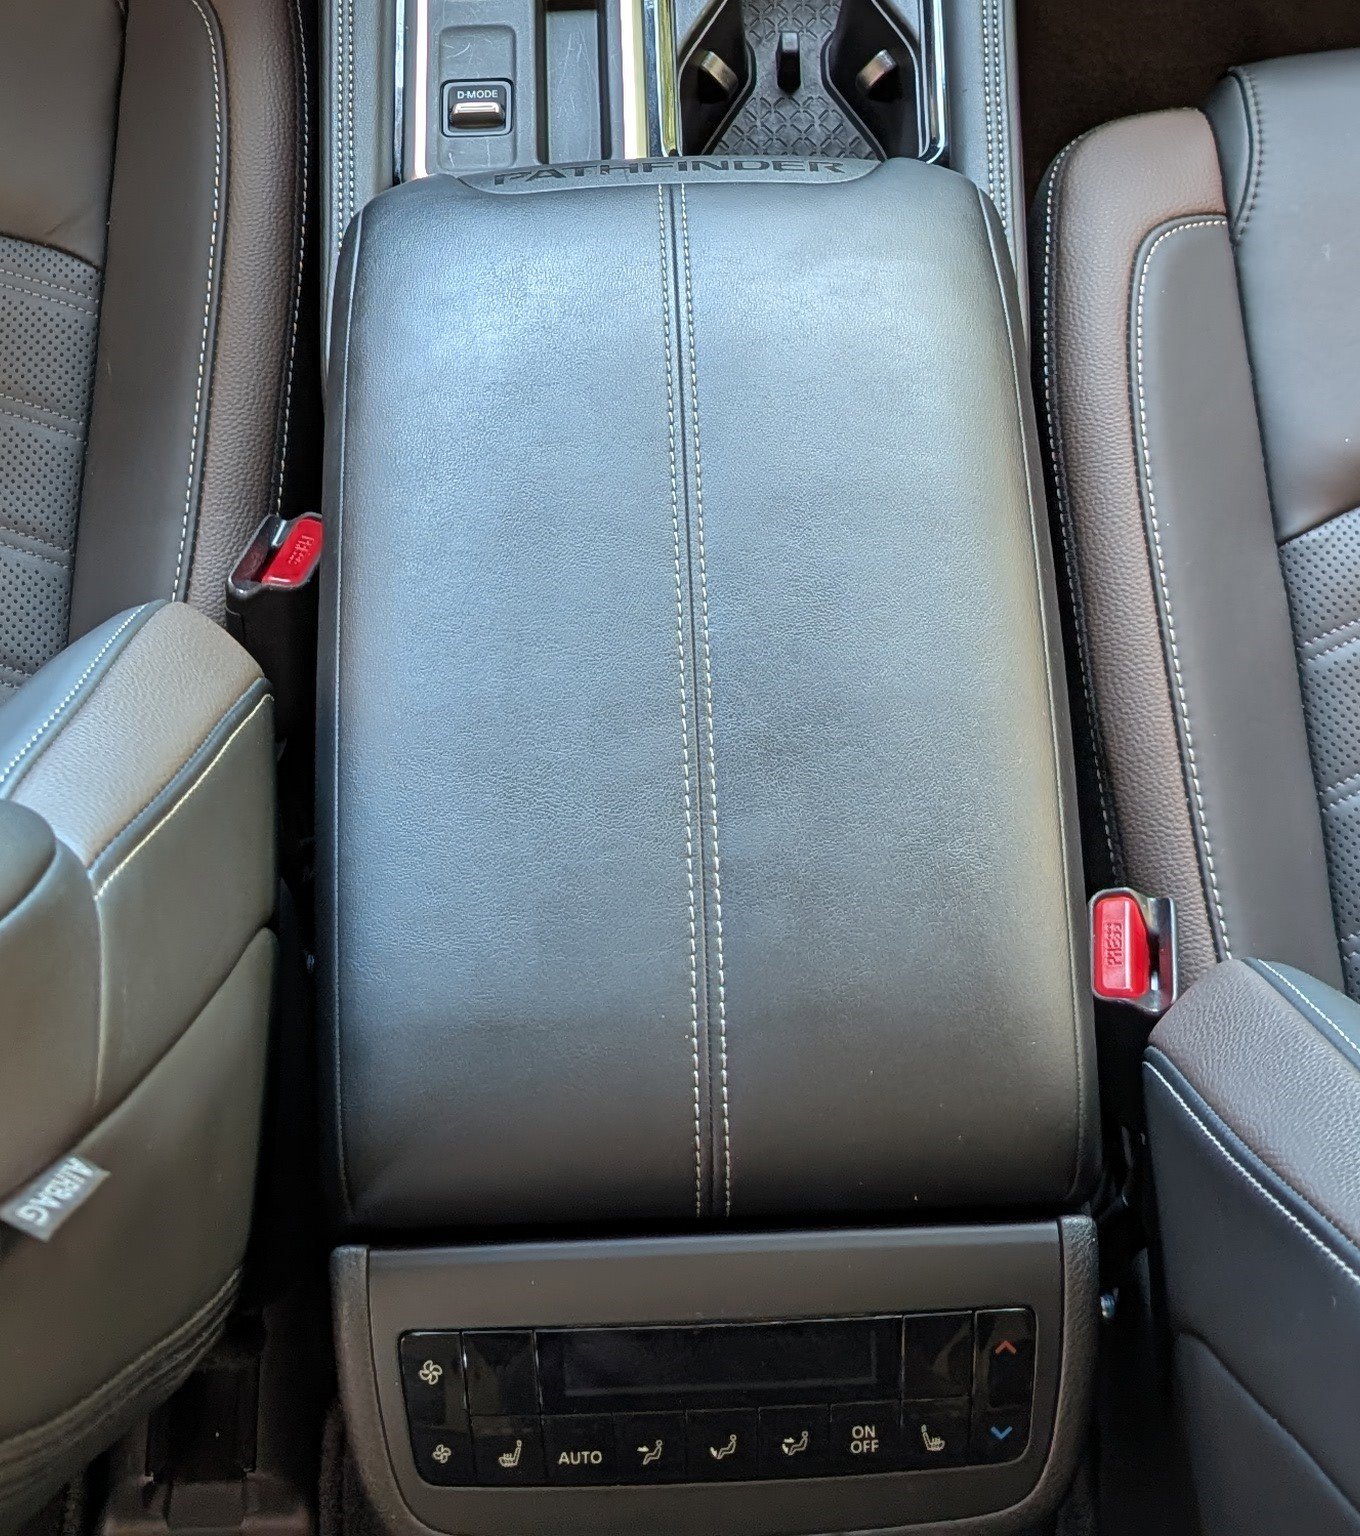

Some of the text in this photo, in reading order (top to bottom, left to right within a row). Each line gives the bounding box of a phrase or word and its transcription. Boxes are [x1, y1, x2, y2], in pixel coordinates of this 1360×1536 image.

[456, 89, 498, 100] D-MODE
[494, 160, 847, 186] PATHFINDER
[851, 1425, 876, 1439] ON
[850, 1439, 879, 1454] OFF
[558, 1450, 603, 1465] AUTO
